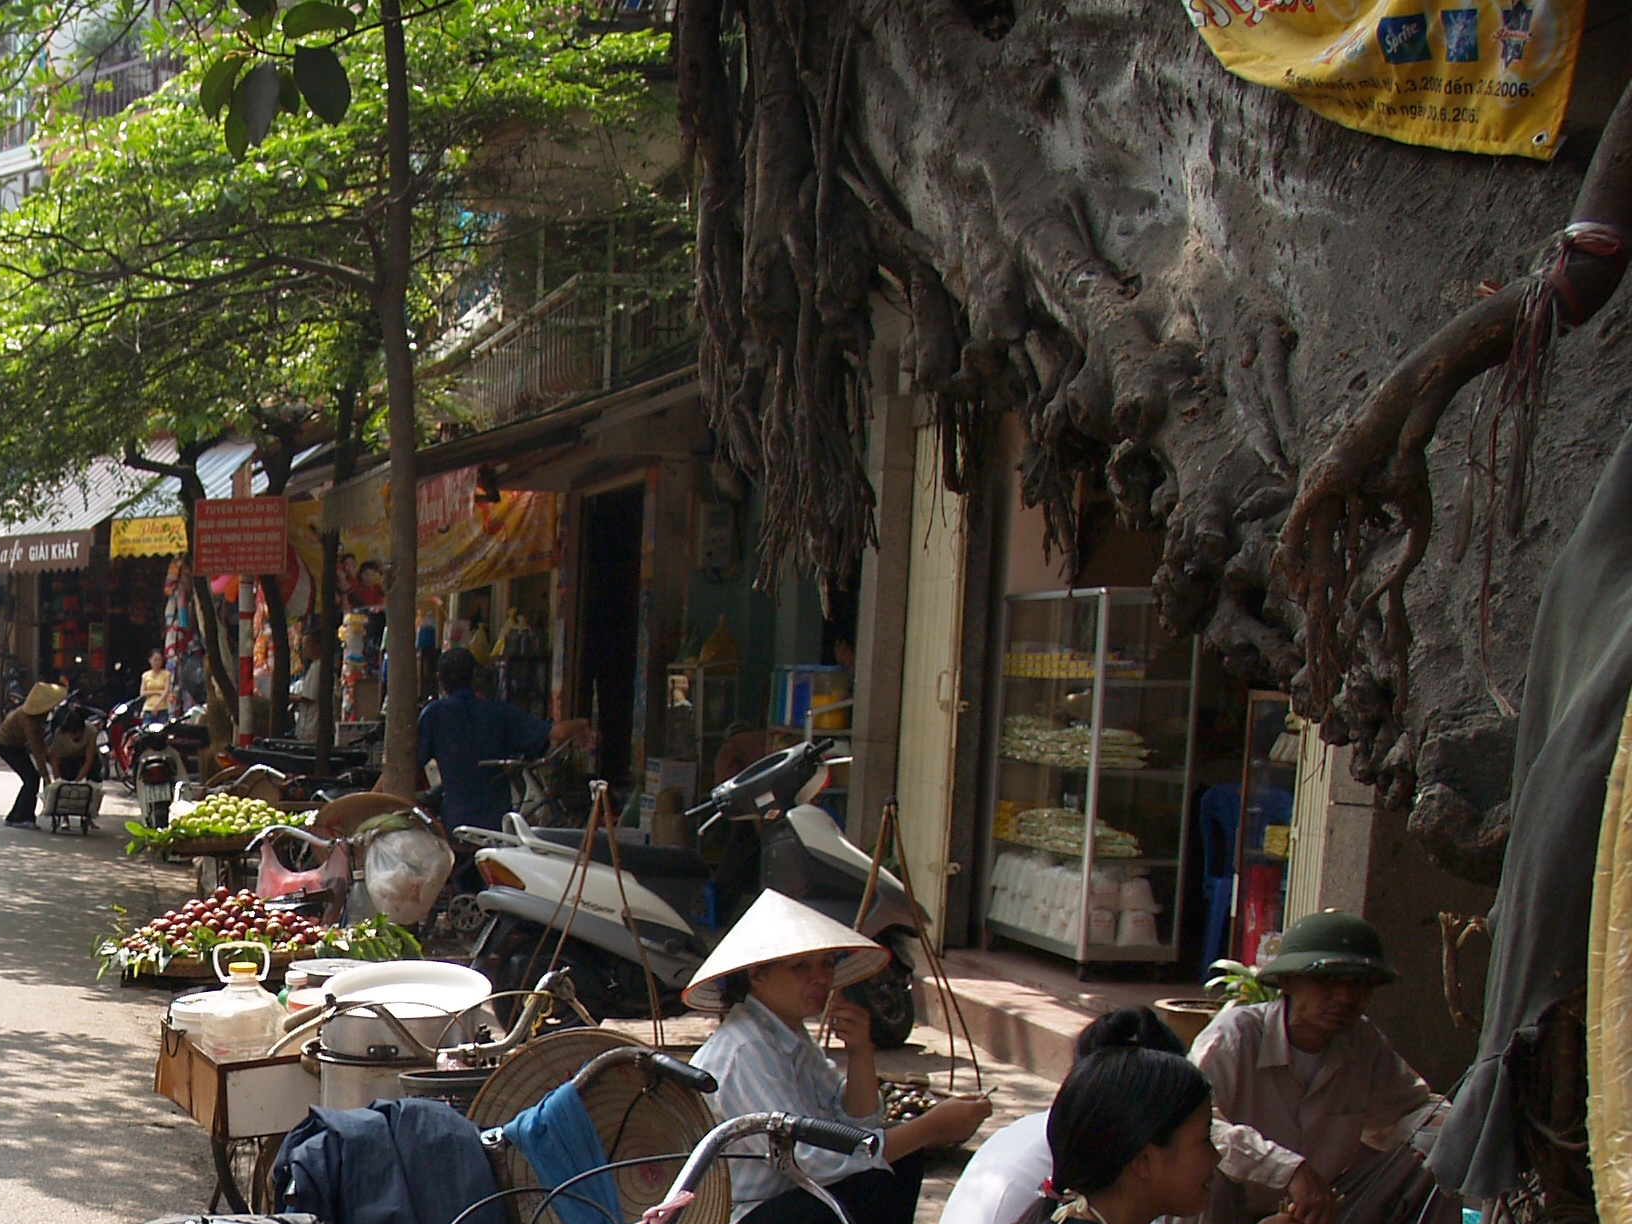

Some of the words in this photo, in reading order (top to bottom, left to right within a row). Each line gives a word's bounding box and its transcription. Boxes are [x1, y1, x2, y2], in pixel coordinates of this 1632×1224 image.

[1383, 22, 1419, 54] Sprite
[1444, 76, 1473, 95] đến
[28, 541, 49, 562] GIẢI
[51, 538, 79, 561] KHÁT
